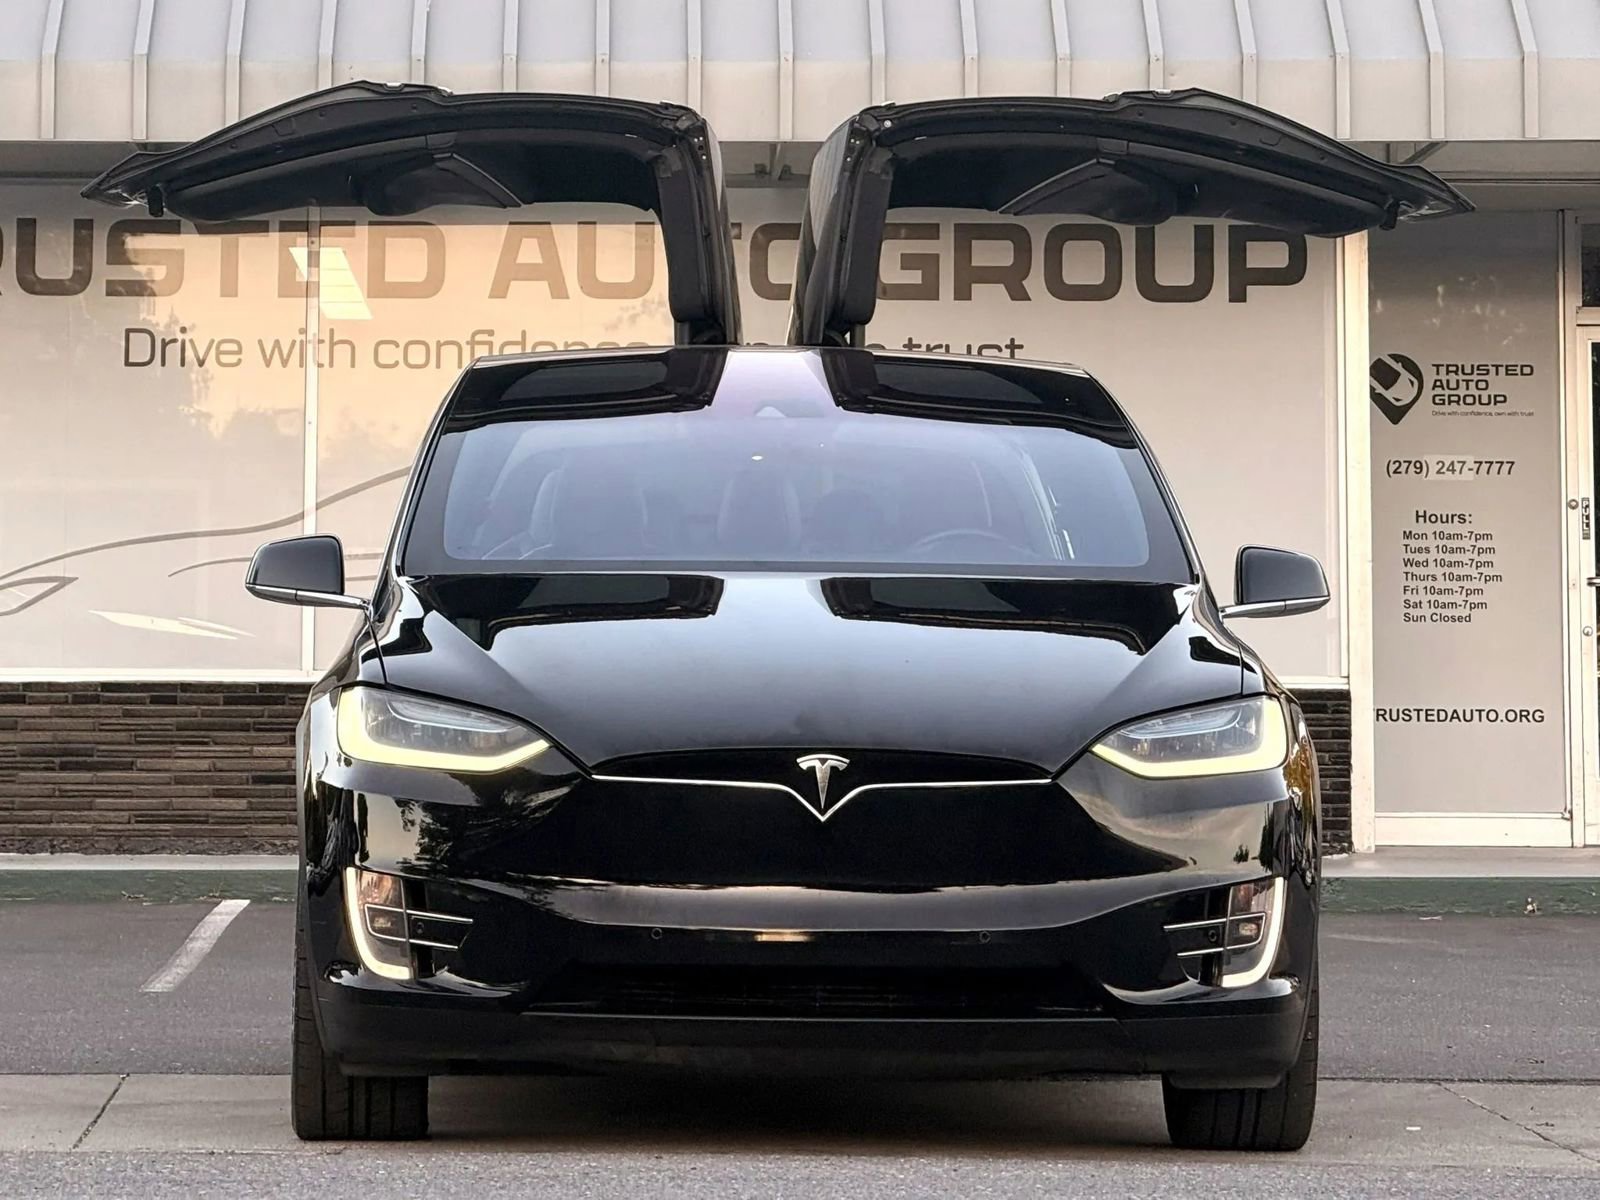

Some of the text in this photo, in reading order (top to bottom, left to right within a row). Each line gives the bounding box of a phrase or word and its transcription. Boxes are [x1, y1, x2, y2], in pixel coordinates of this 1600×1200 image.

[0, 218, 1307, 303] USTED AUO GROUP
[124, 328, 243, 368] Drive
[257, 328, 356, 368] with
[1431, 363, 1534, 376] TRUSTED
[1431, 379, 1489, 391] AUTO
[1431, 394, 1507, 406] GROUP
[1385, 459, 1516, 478] (279) 247-7777
[1415, 509, 1473, 525] Hours:
[1402, 530, 1493, 543] Mon 10am-7pm
[1402, 544, 1496, 556] Tues 10am-7pm
[1402, 558, 1494, 570] Wed 10am-7pm
[1402, 571, 1503, 584] Thurs 10am-7pm
[1402, 585, 1484, 598] Fri 10am-7pm
[1402, 599, 1488, 611] Sat 10am-7pm
[1402, 612, 1472, 624] Sun Closed
[1373, 708, 1545, 723] RUSTEDAUTO.ORG
